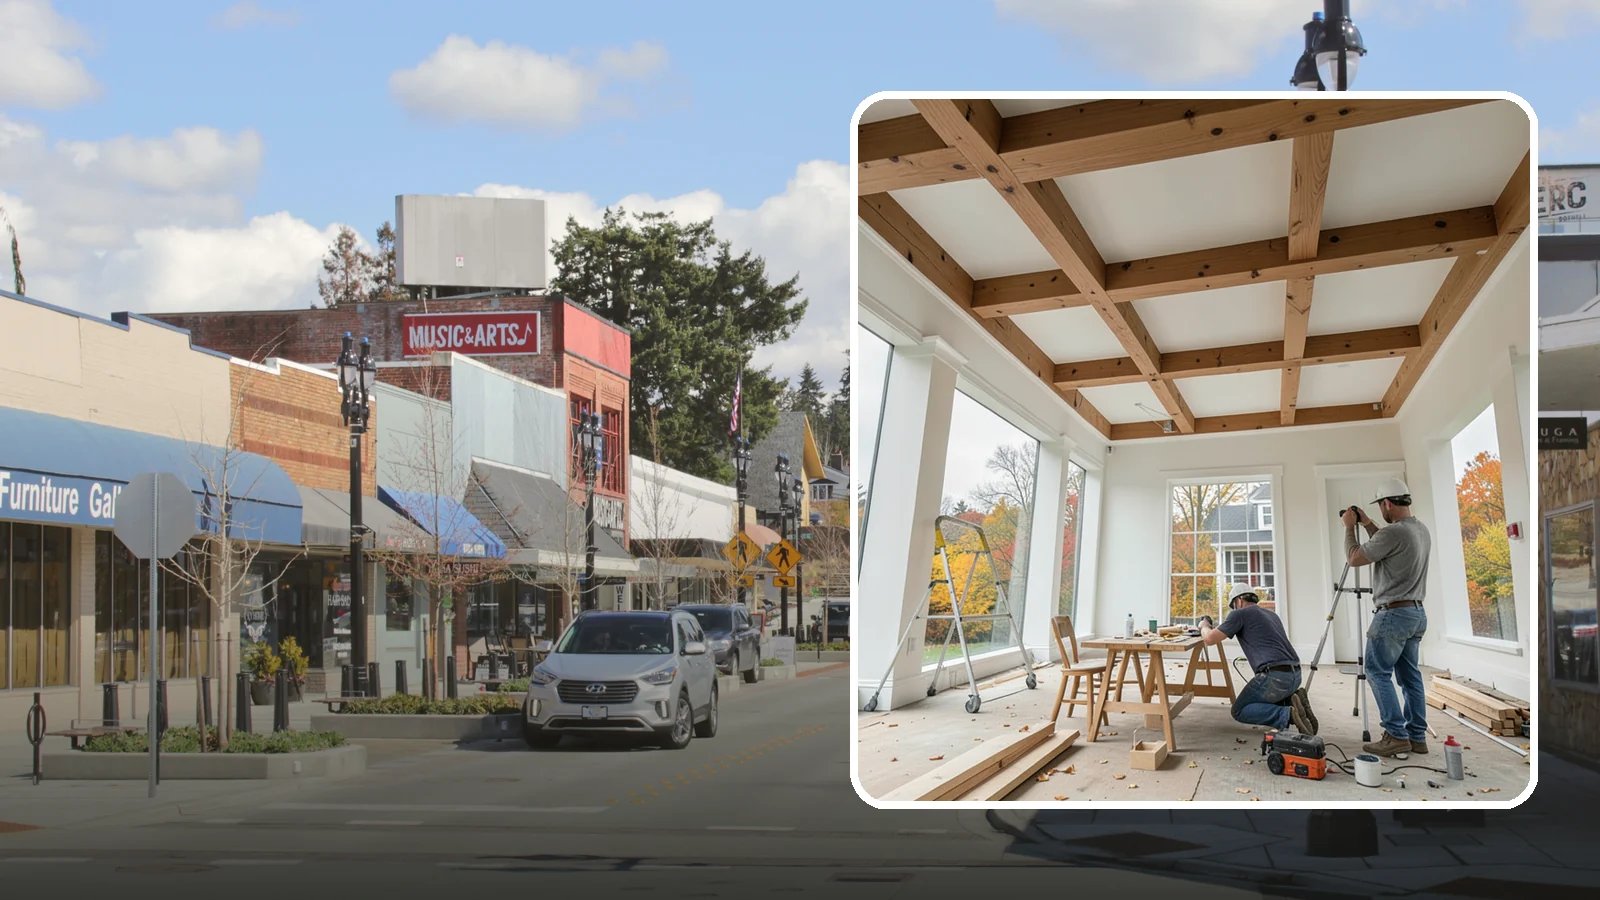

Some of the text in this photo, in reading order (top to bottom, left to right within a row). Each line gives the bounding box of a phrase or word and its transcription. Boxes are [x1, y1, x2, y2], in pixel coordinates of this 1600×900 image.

[1538, 181, 1587, 213] ERC
[409, 323, 520, 348] MUSIC&ARTS
[0, 472, 121, 519] Furniture Gal
[453, 563, 480, 574] SUSHI
